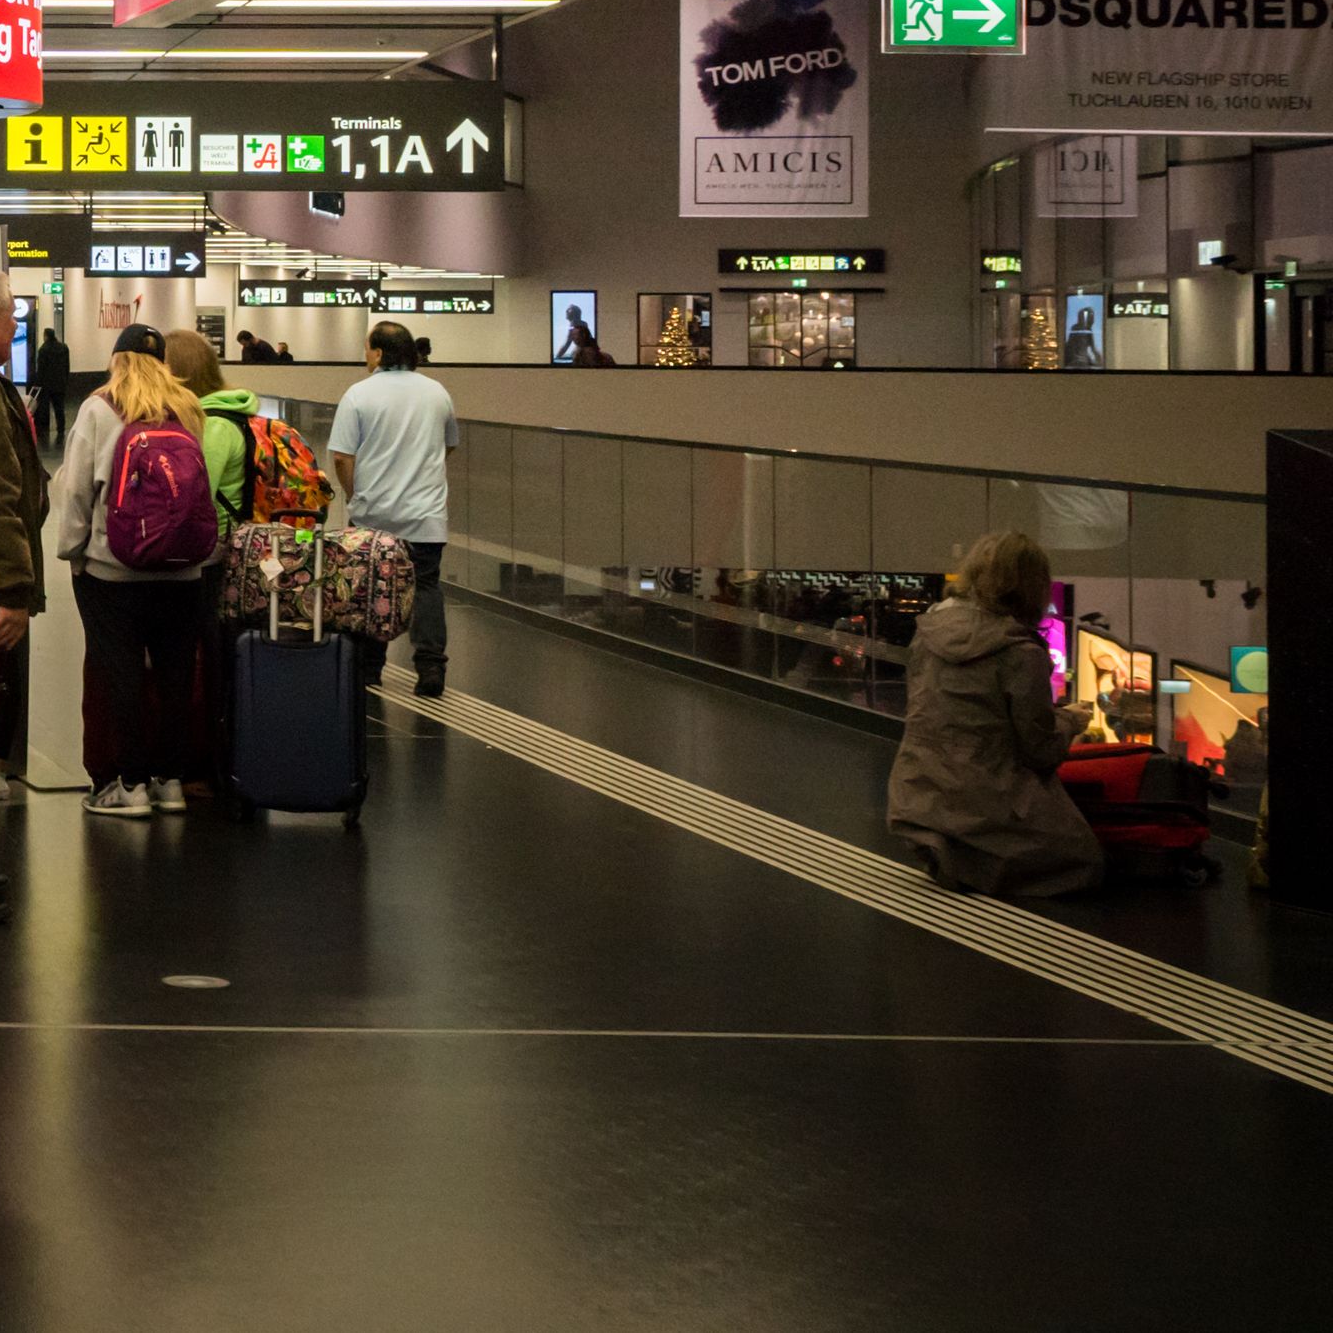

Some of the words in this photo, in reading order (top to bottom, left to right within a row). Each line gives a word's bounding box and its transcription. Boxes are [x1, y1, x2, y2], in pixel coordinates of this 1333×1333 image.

[705, 59, 766, 87] TOM
[768, 48, 843, 77] FORD
[1091, 71, 1133, 85] NEW
[1137, 71, 1224, 87] FLAGSHIP
[1228, 72, 1289, 87] STORE
[1068, 93, 1188, 108] TUCHLAUBEN
[1225, 95, 1261, 109] 1010
[1267, 95, 1312, 111] WIEN
[331, 116, 402, 130] Terminals
[331, 135, 434, 180] 1,1A
[705, 152, 842, 174] AMICIS
[7, 240, 28, 249] rport
[99, 288, 131, 329] Austrian
